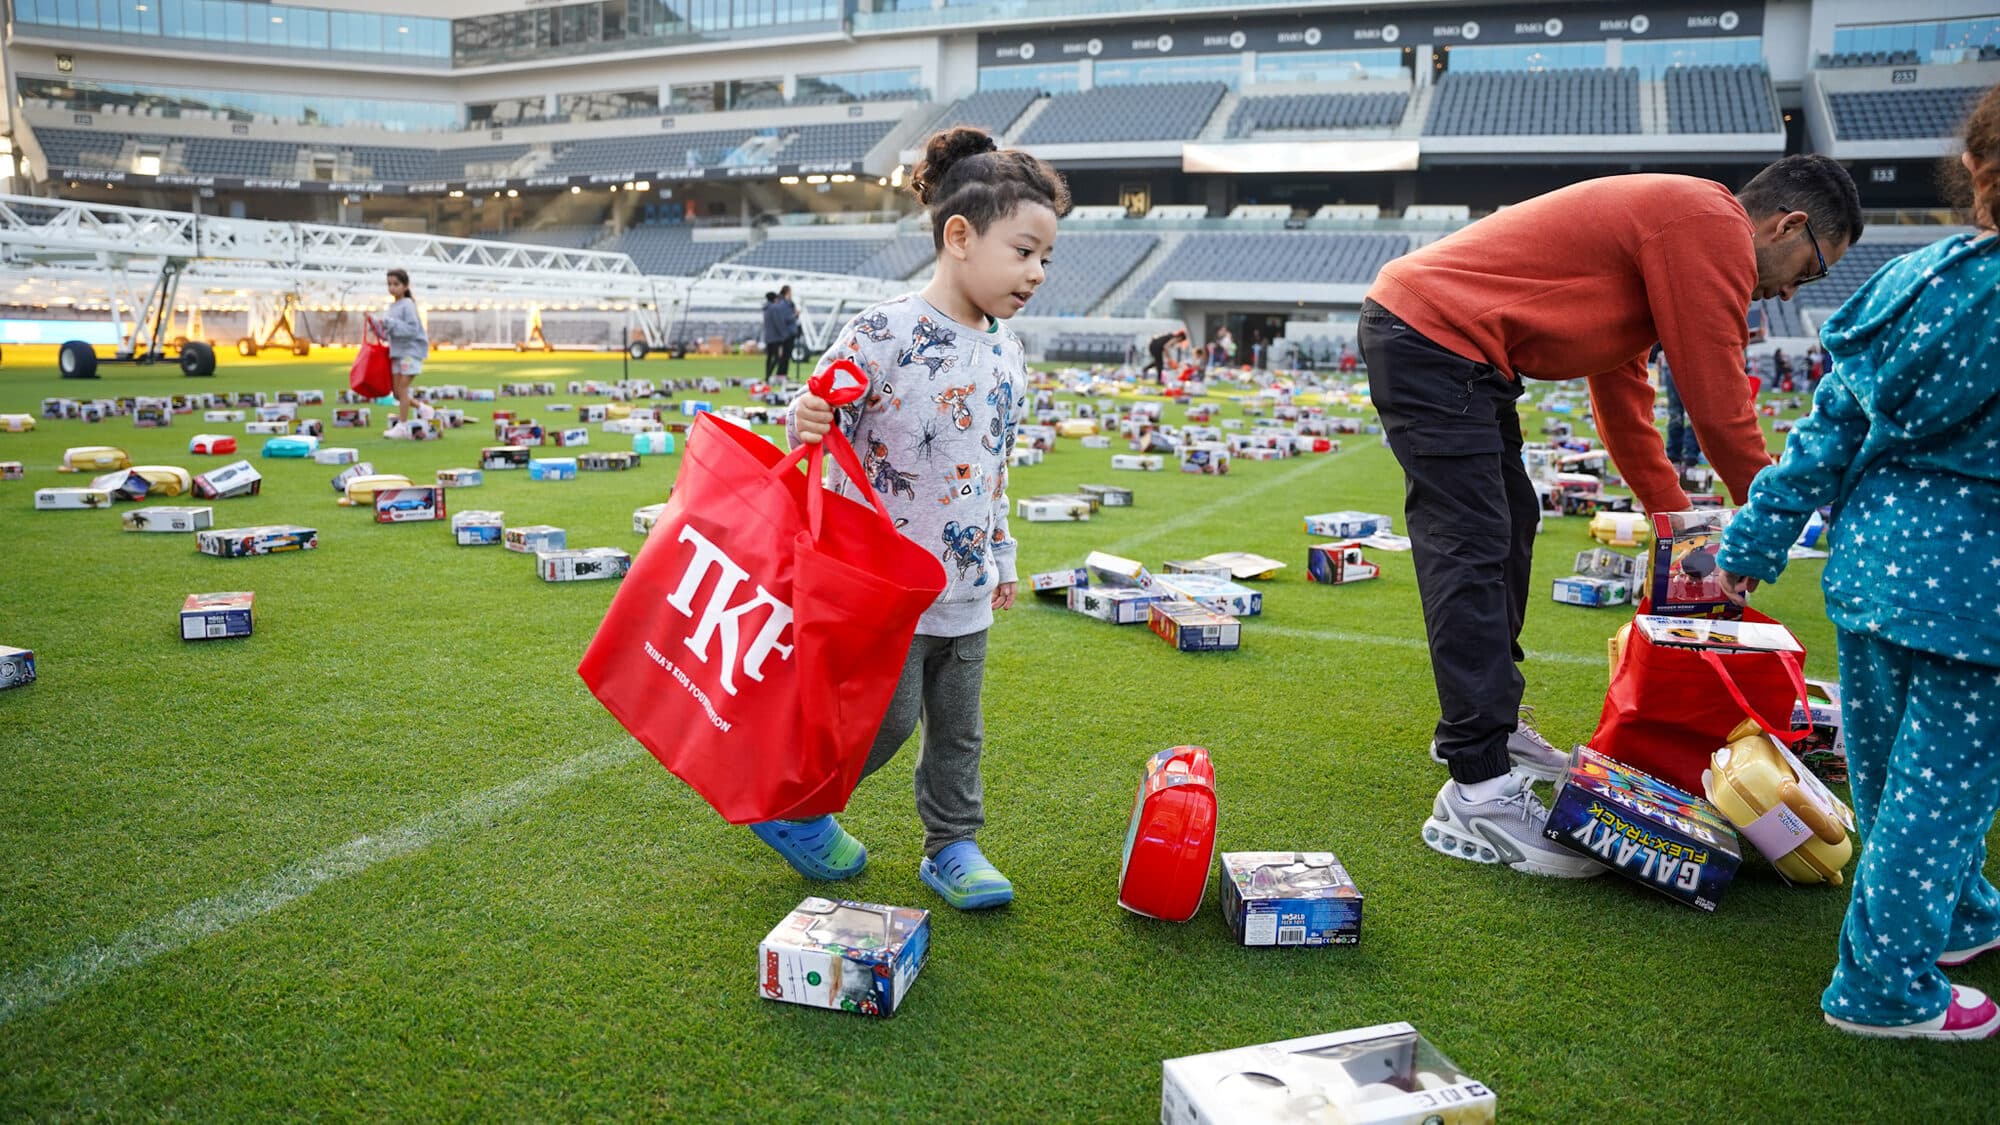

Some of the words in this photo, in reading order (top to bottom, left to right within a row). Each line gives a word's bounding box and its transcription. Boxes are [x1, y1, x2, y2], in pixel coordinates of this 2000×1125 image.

[644, 641, 673, 671] TRINA'S
[672, 668, 690, 687] KIDS
[1546, 829, 1559, 840] 3+
[1572, 817, 1701, 891] GALAXY
[1588, 801, 1708, 865] FLEX-TRACK
